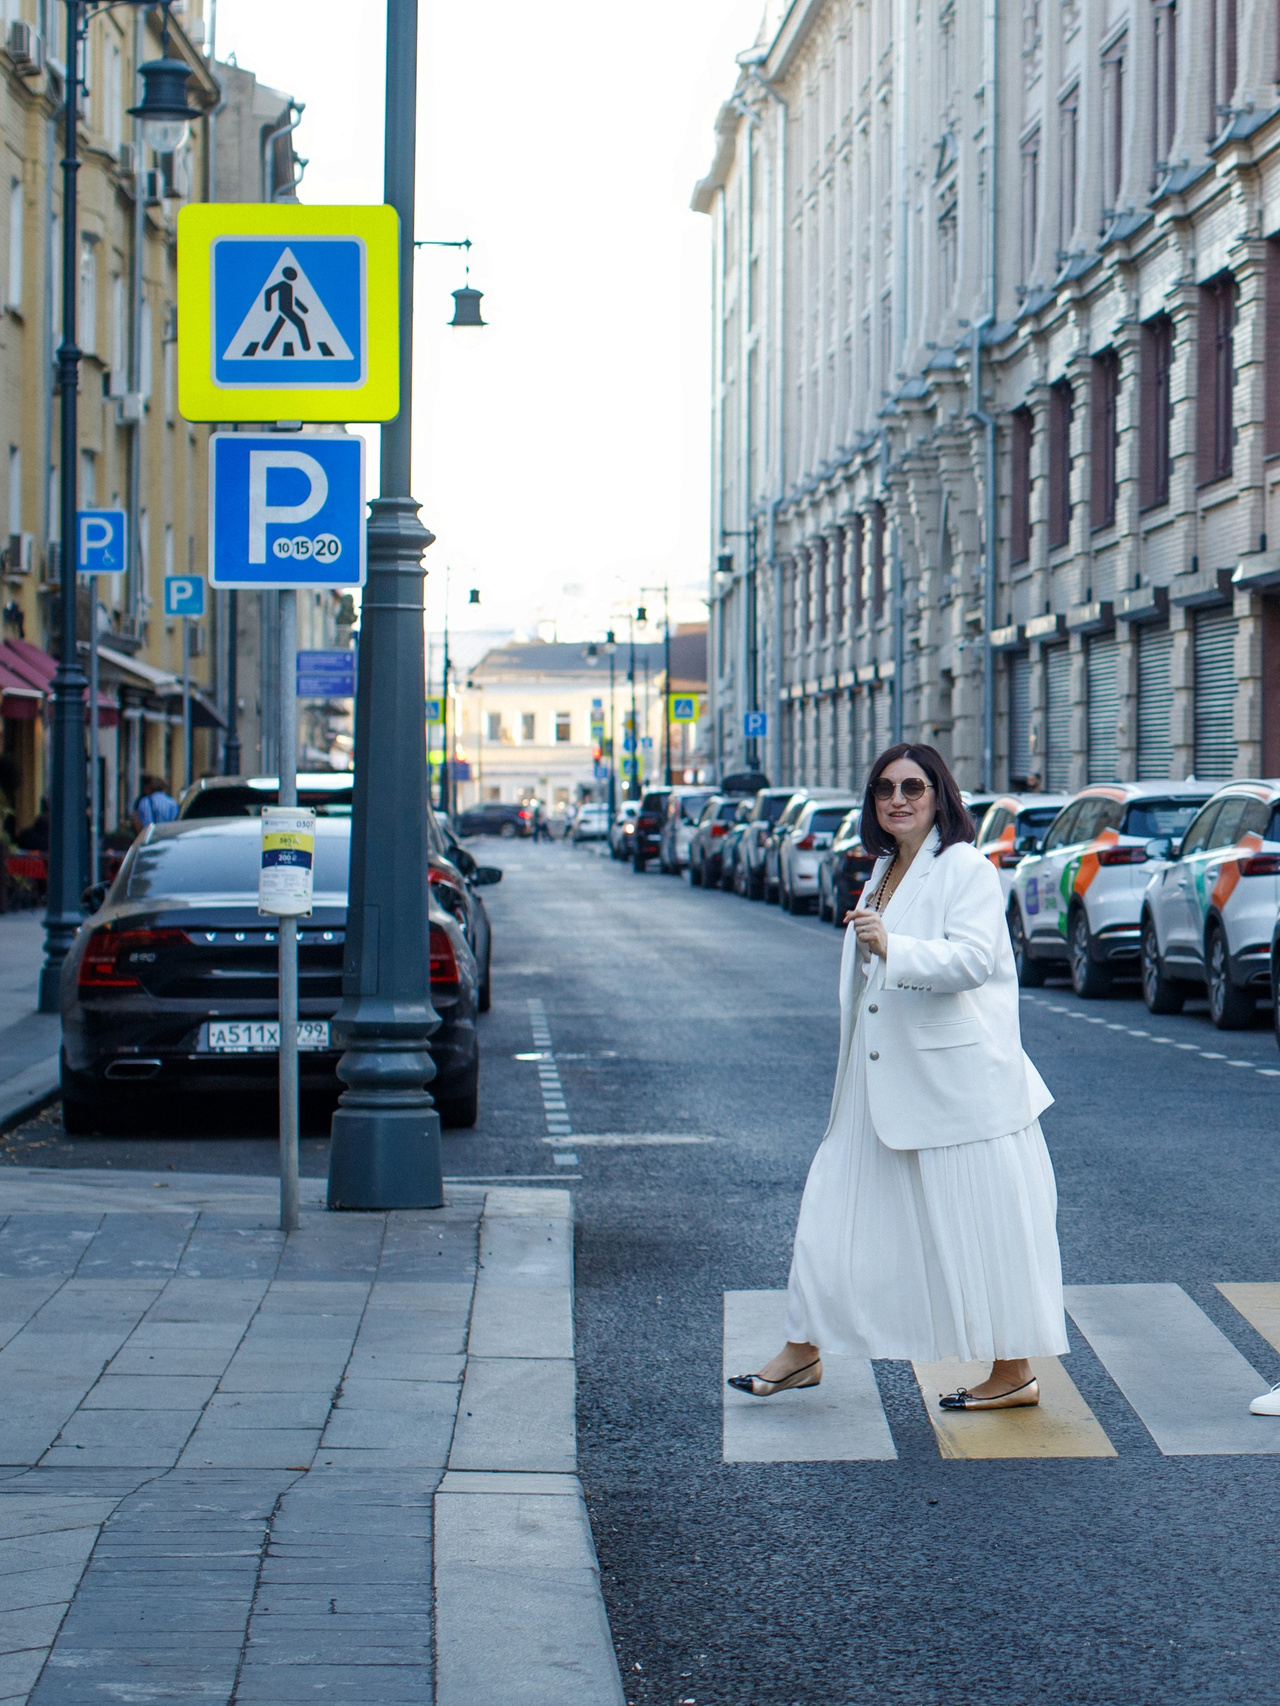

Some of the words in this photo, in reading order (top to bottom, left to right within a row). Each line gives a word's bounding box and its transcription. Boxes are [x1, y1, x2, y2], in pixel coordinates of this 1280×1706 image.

[249, 450, 329, 564] P
[80, 517, 113, 565] P
[278, 543, 289, 553] 10
[294, 541, 310, 555] 15
[315, 539, 339, 556] 20
[170, 580, 193, 611] P
[748, 714, 762, 733] P
[205, 931, 333, 941] VOLVO
